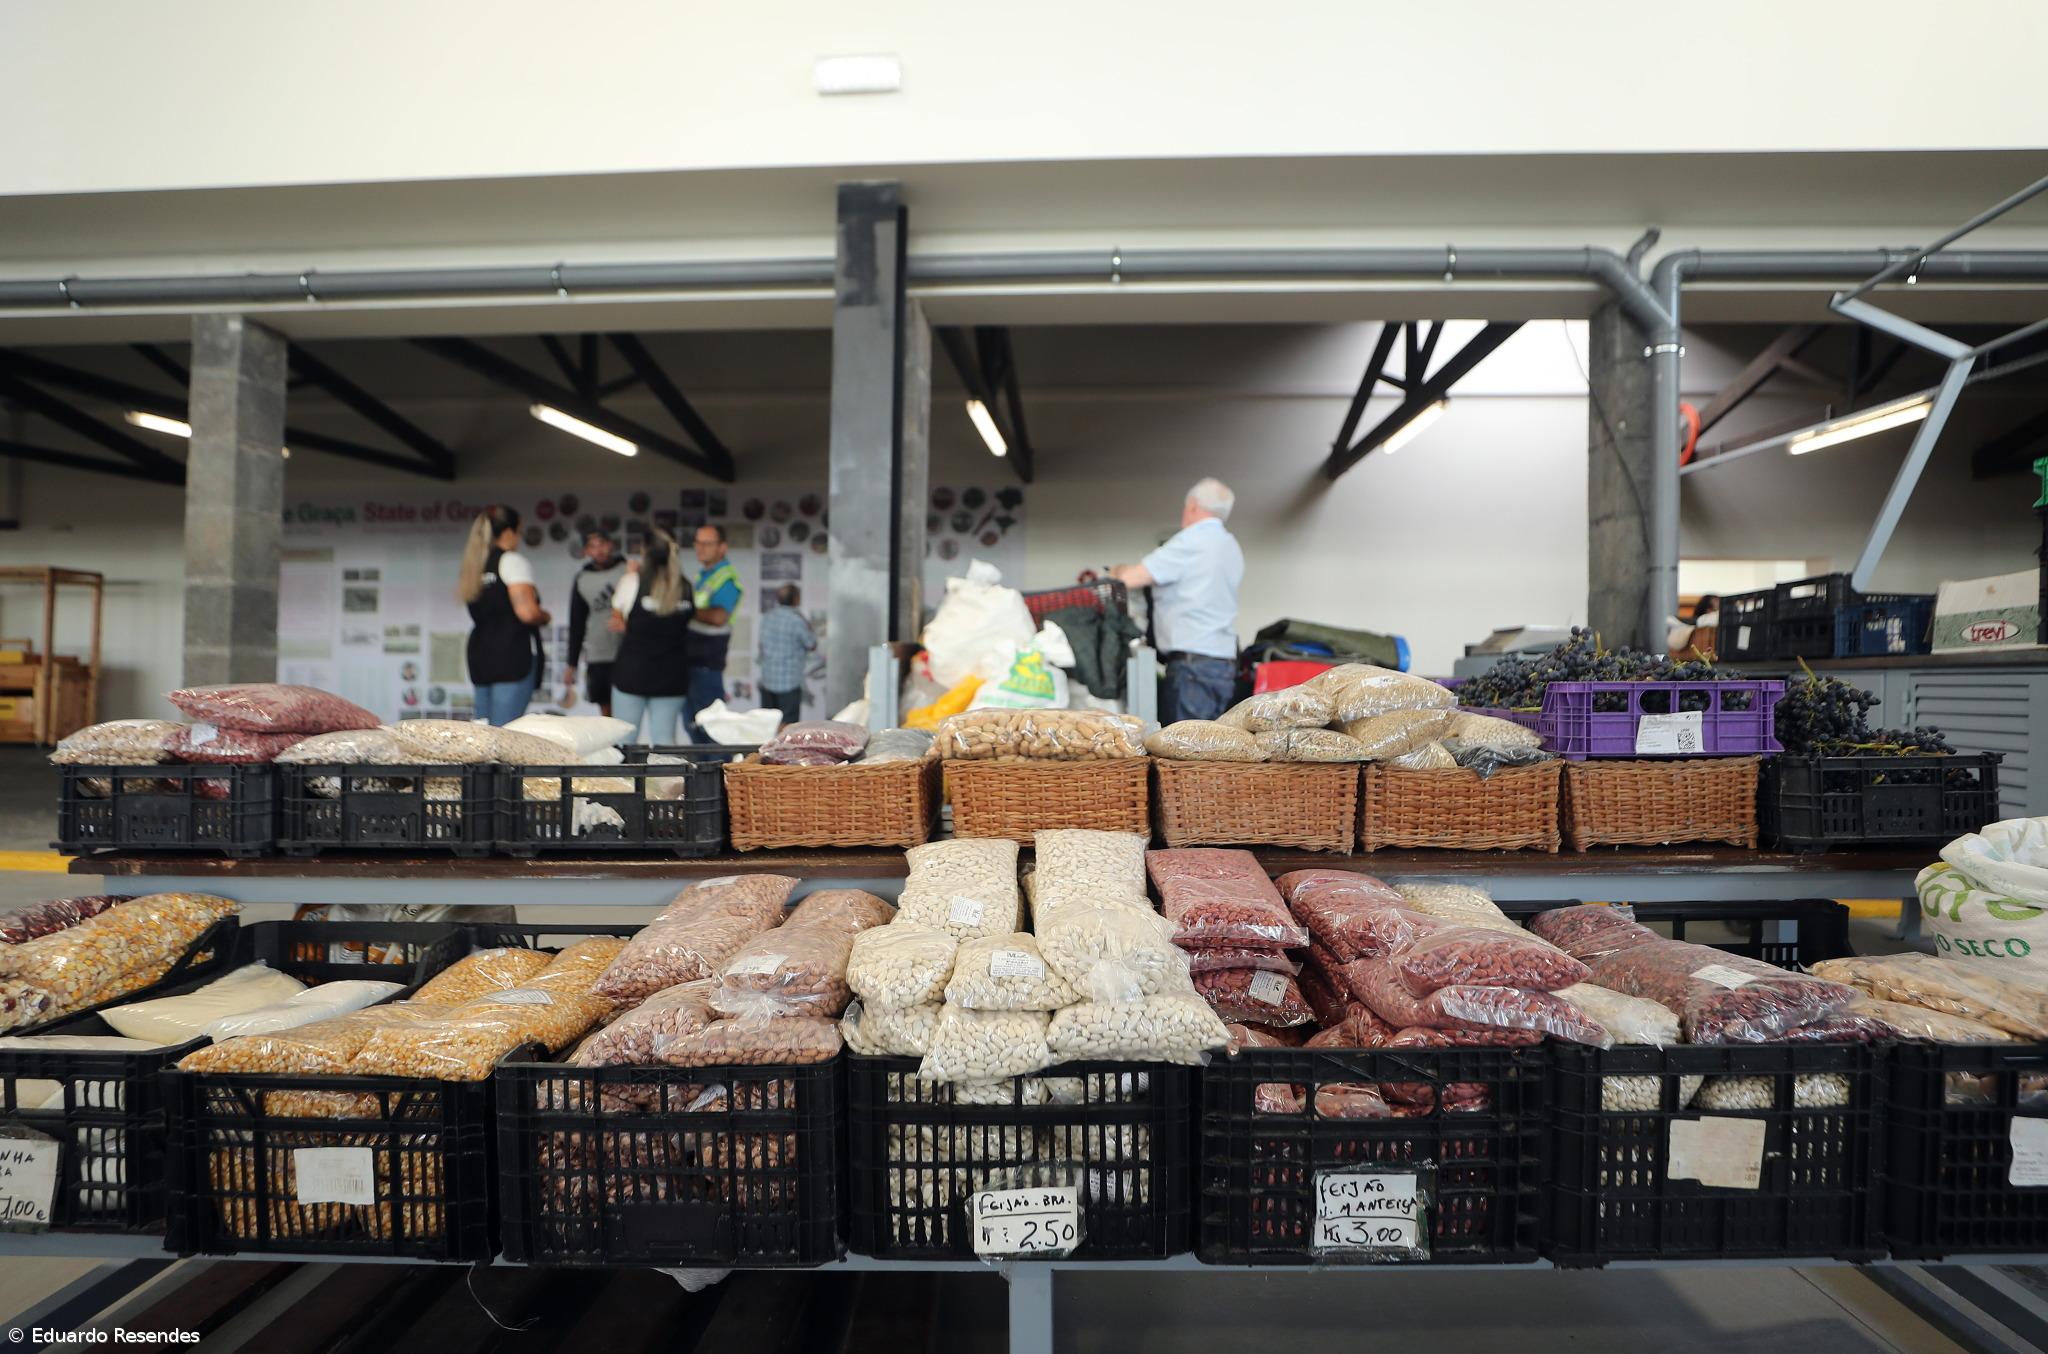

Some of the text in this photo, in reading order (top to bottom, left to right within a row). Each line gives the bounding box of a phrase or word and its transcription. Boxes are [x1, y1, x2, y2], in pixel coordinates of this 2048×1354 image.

[297, 502, 356, 526] Graça
[363, 501, 417, 522] State
[420, 500, 443, 522] of
[1970, 620, 2007, 642] trevi
[1954, 937, 2032, 958] SECO
[1019, 1219, 1075, 1250] 2.50
[1345, 1221, 1403, 1246] 3,00
